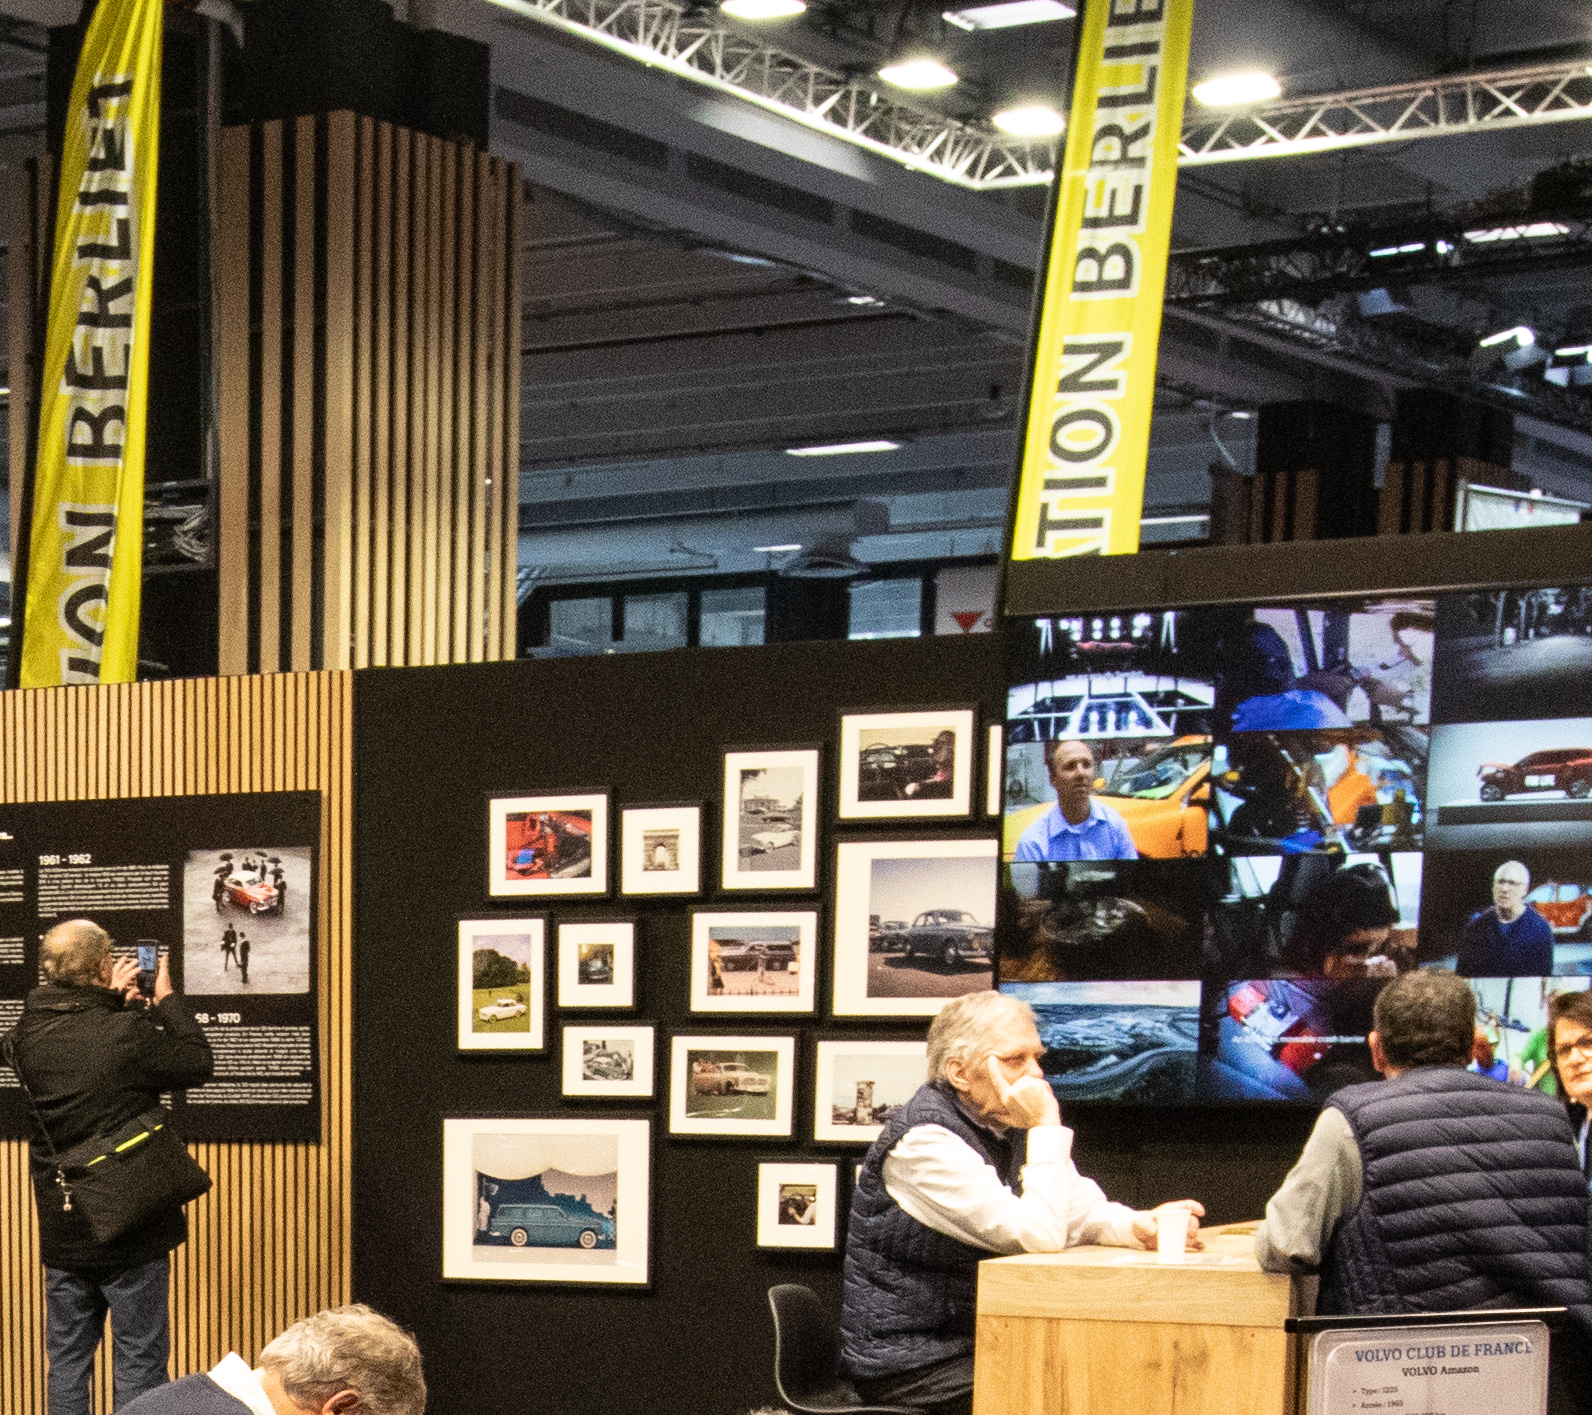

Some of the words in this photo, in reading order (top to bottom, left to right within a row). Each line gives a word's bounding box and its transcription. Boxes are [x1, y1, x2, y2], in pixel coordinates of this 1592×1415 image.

[1036, 340, 1126, 551] TION
[217, 1012, 241, 1024] 1970
[1354, 1347, 1402, 1363] VOLVO
[1405, 1345, 1446, 1360] CLUB
[1449, 1343, 1470, 1358] DE
[1473, 1339, 1533, 1356] FRANCE
[1401, 1365, 1437, 1377] VOLVO
[1439, 1364, 1480, 1374] Amazon
